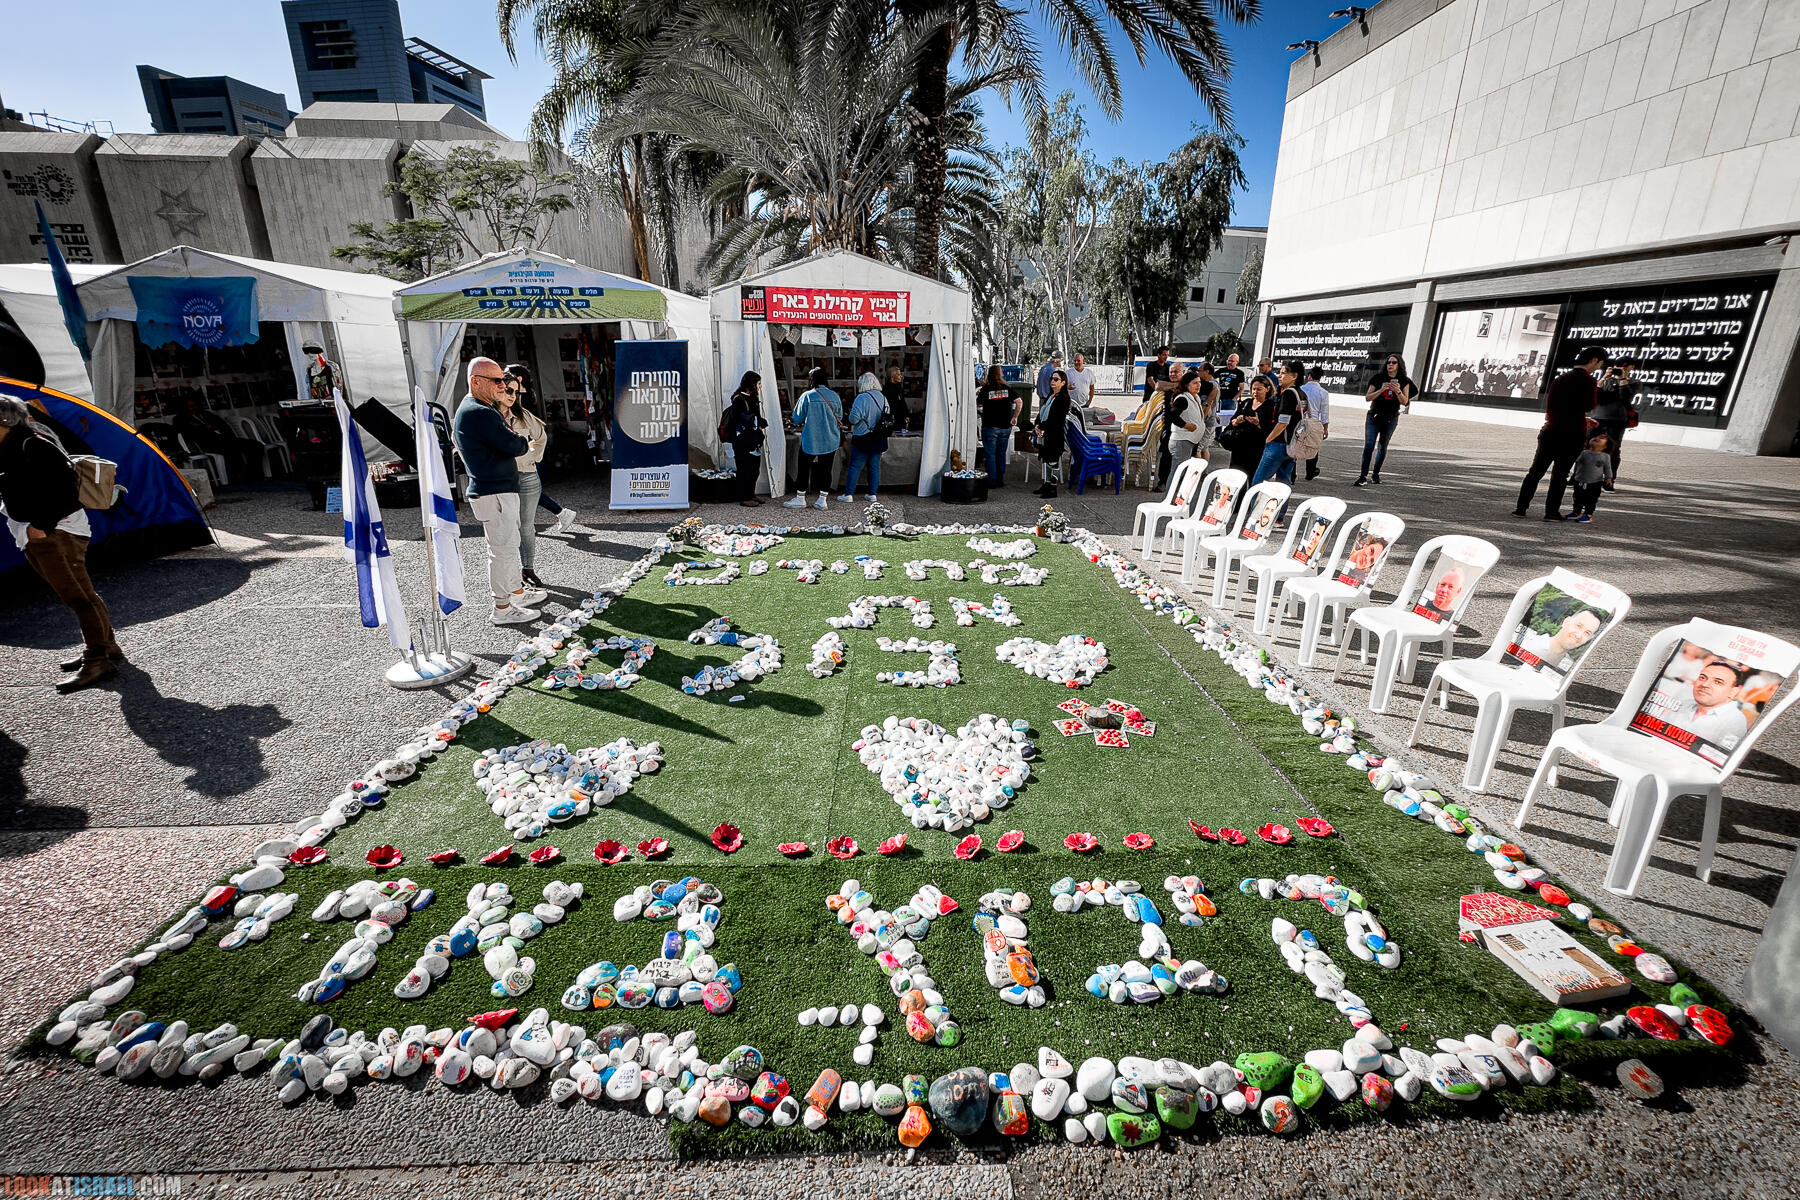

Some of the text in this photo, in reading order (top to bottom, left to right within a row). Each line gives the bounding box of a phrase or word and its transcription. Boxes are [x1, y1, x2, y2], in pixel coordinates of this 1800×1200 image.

[772, 293, 809, 308] בארי
[814, 294, 864, 313] קהילת
[869, 297, 896, 310] קיבוץ
[1602, 294, 1752, 317] אנו מכריזים בזאת על
[183, 316, 222, 328] NOVA
[772, 310, 808, 319] והנעדרים
[809, 312, 842, 320] החטופים
[844, 312, 864, 321] למען
[873, 311, 896, 322] בארי
[1278, 324, 1286, 332] We
[1286, 323, 1304, 334] hereby
[1304, 322, 1322, 332] declare
[1334, 319, 1372, 331] unrelenting
[1568, 320, 1742, 339] מחויבותנו הבלתי מתפשרת
[1276, 332, 1381, 346] commitment to the values proclaimed
[1274, 347, 1369, 359] in the Declaration of Independence,
[1638, 342, 1681, 360] מגילת
[1686, 342, 1734, 362] לערכי
[1322, 361, 1332, 370] the
[1332, 362, 1341, 371] Tel
[1342, 362, 1356, 372] Aviv
[631, 371, 680, 388] מחזירים
[1660, 370, 1726, 386] שנחתמה
[628, 388, 680, 404] את האור
[1649, 394, 1684, 408] באייר
[651, 403, 680, 420] שלנו
[640, 422, 680, 438] הביתה
[662, 472, 670, 480] לא
[1648, 691, 1680, 712] BRING
[1635, 713, 1697, 746] HOME NOW!
